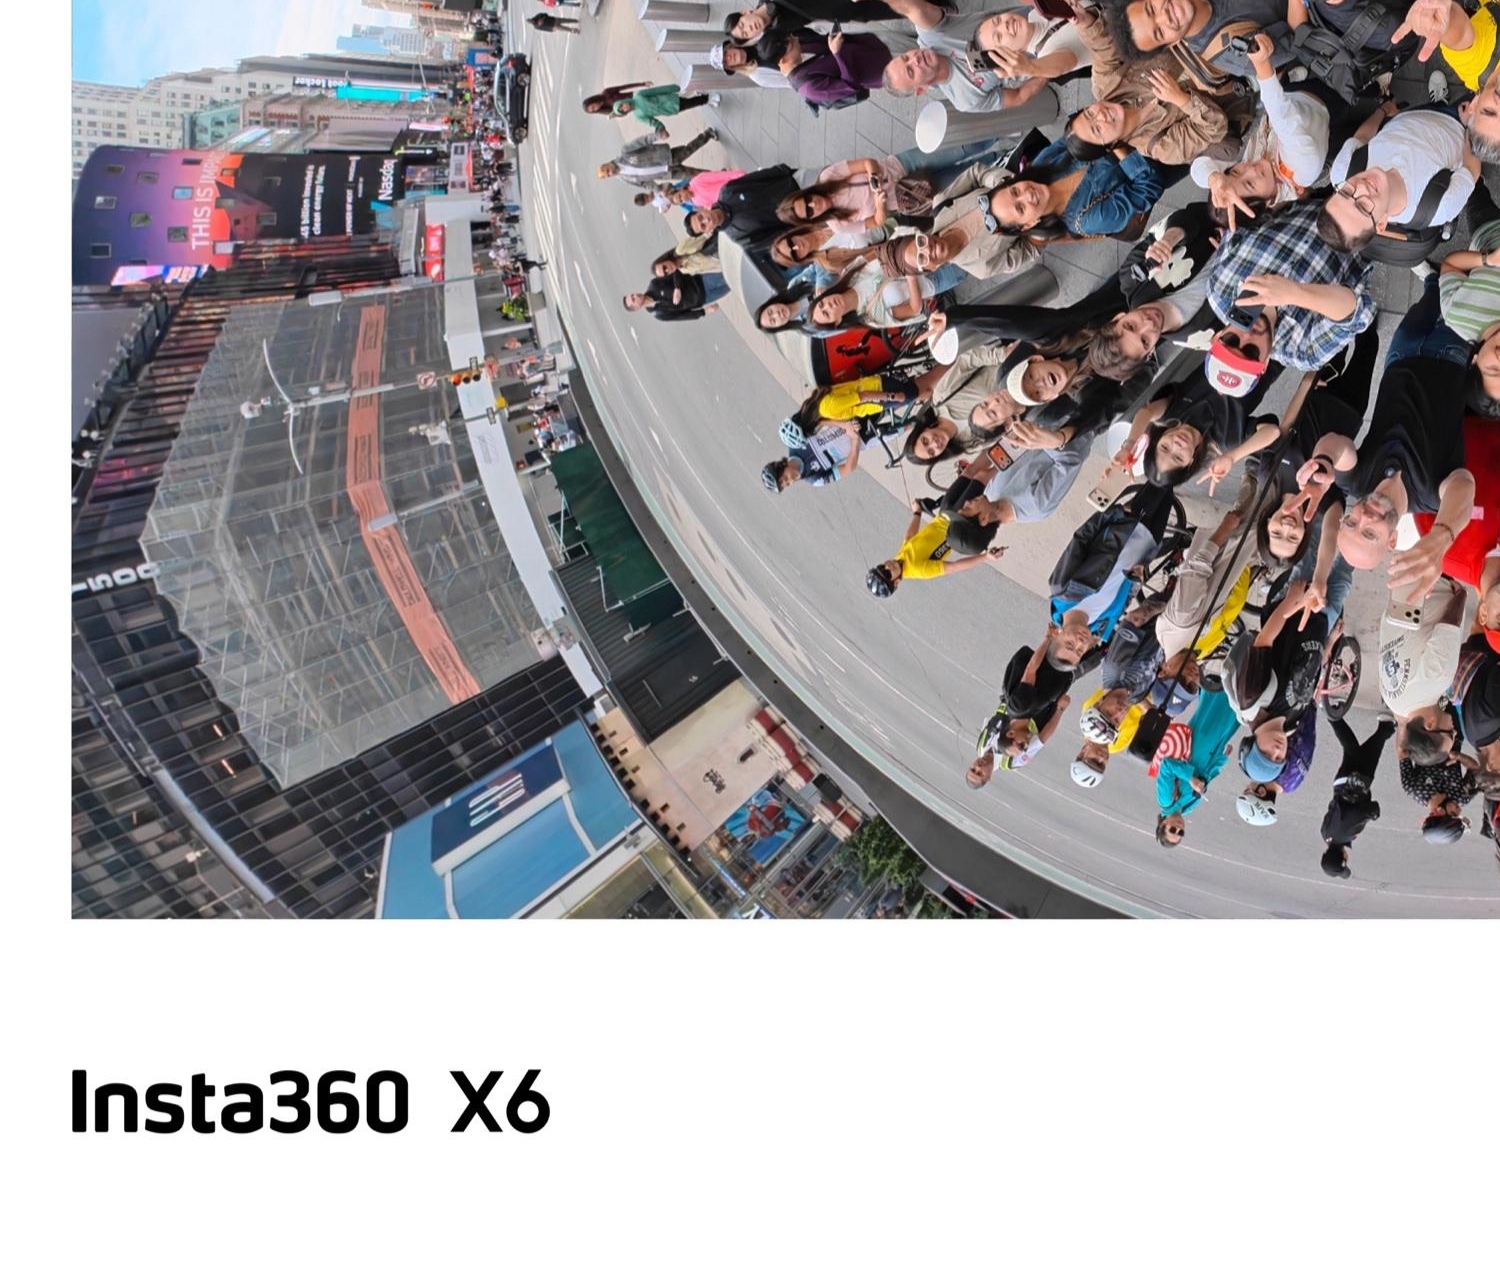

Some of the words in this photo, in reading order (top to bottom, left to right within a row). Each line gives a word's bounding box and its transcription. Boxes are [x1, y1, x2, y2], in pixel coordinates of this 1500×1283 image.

[195, 188, 214, 202] IS
[378, 159, 399, 200] Nasdaq
[191, 206, 213, 250] THIS
